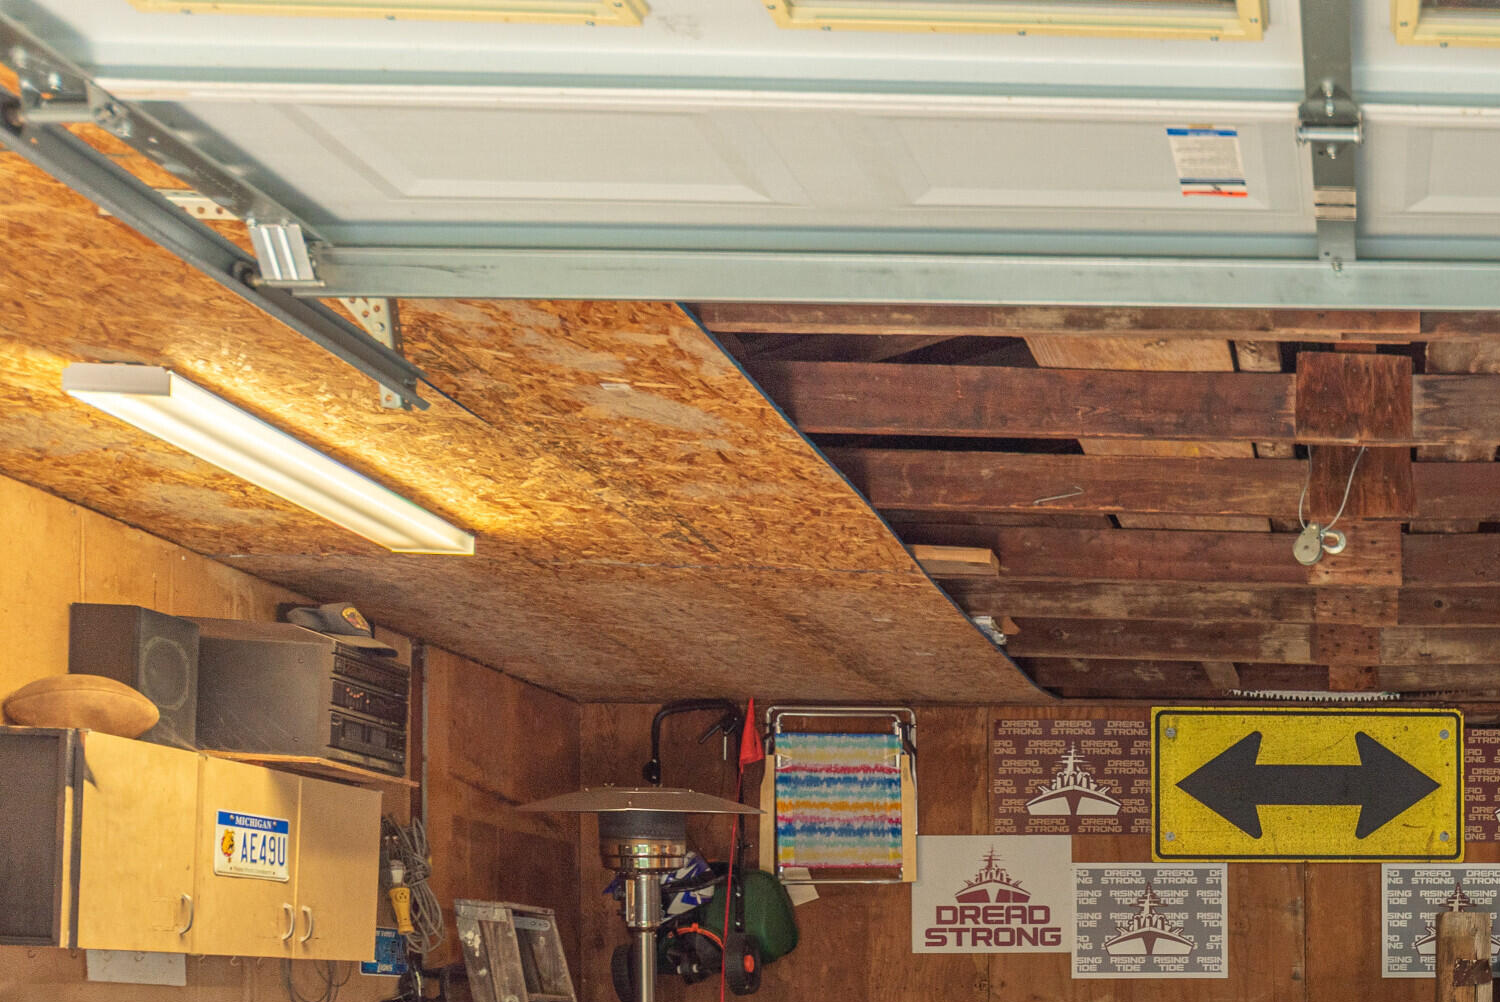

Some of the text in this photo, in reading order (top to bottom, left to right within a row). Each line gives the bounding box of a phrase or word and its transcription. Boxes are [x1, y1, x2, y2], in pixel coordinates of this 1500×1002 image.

[1104, 728, 1148, 736] STRONG
[1080, 740, 1118, 748] DREAD
[999, 767, 1043, 775] STRONG
[235, 815, 272, 829] MICHIGAN
[240, 832, 286, 866] AE49U
[935, 905, 1050, 925] DREAD
[925, 927, 1061, 947] STRONG
